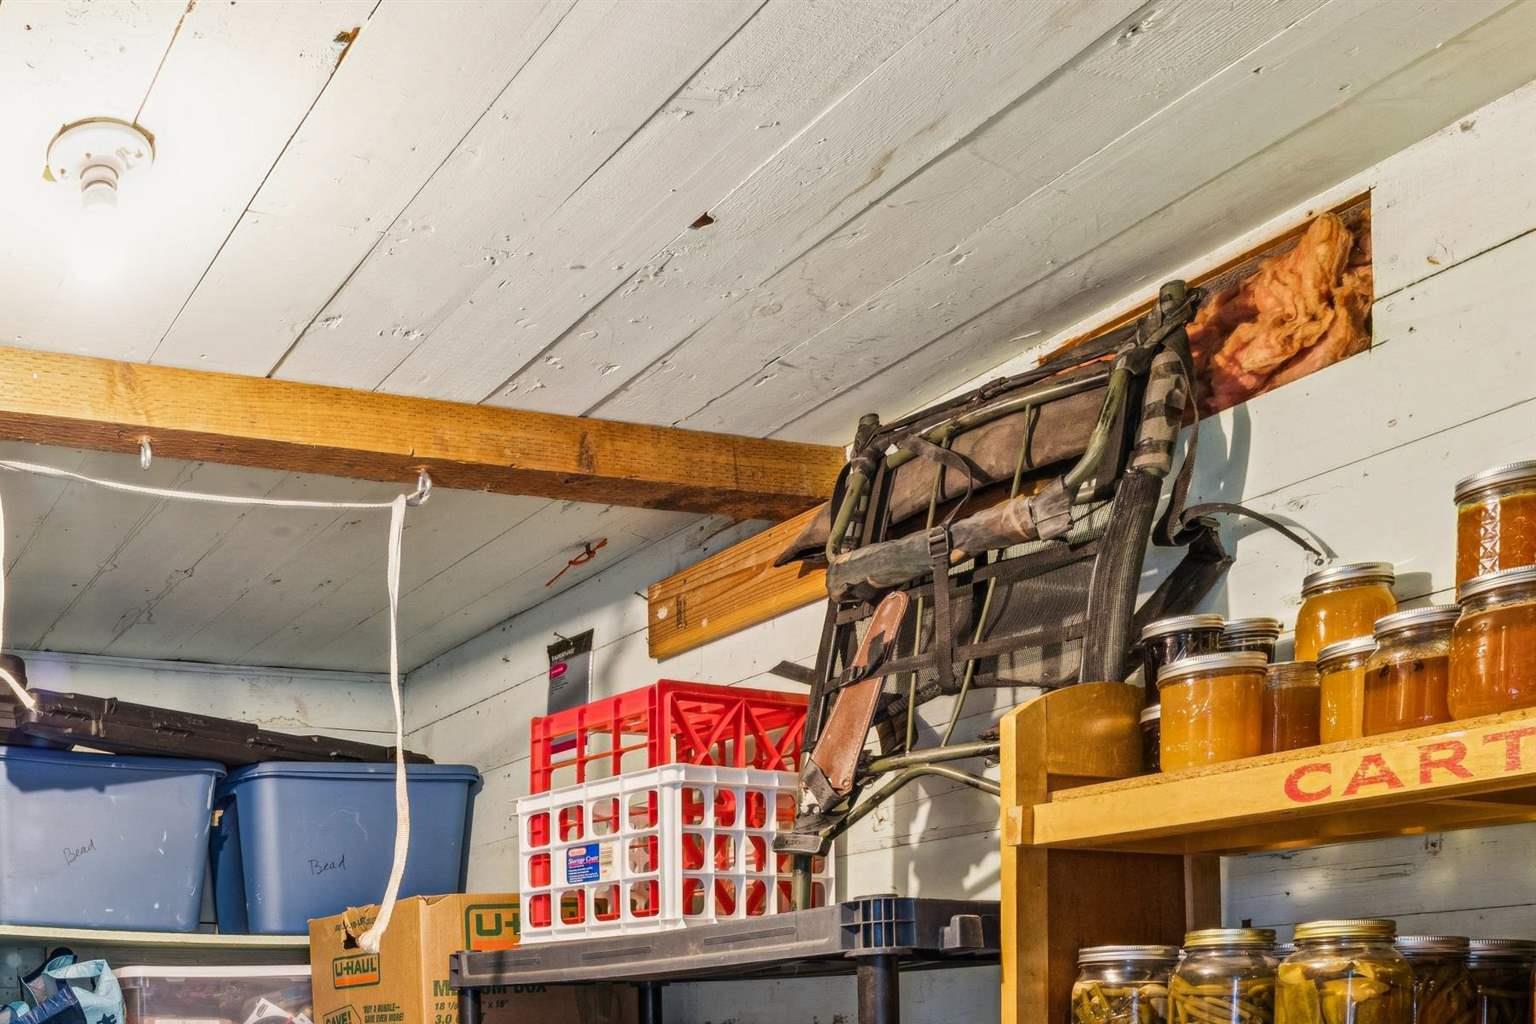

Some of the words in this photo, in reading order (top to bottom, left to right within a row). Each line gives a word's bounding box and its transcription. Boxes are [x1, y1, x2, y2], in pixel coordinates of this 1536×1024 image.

[1284, 726, 1536, 803] CART
[307, 854, 348, 876] Bead
[335, 958, 378, 977] U-HAUL
[434, 1013, 452, 1024] 3.0
